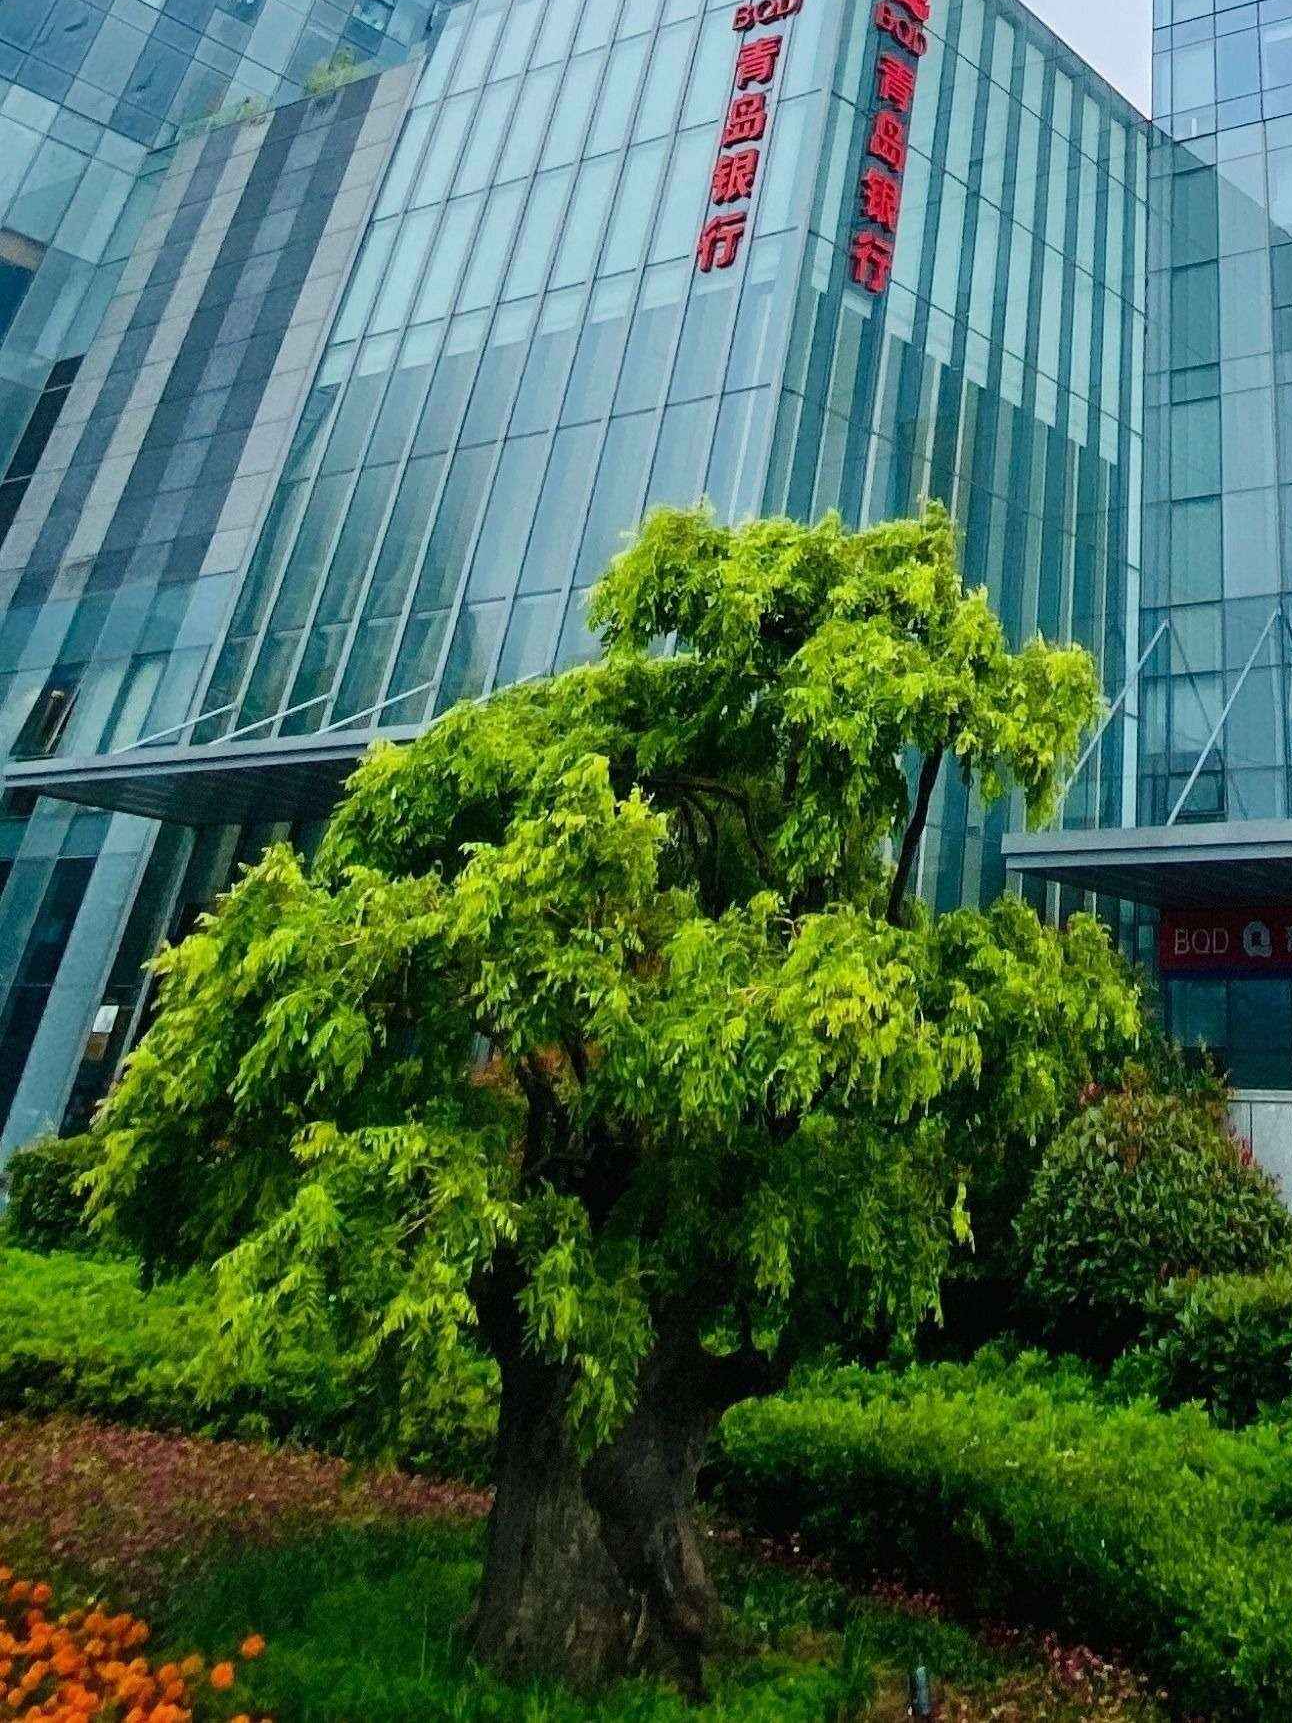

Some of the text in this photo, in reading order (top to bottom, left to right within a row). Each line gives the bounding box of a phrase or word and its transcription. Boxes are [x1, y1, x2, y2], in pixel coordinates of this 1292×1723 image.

[697, 34, 784, 273] 青岛银行
[851, 53, 914, 295] 青岛银行
